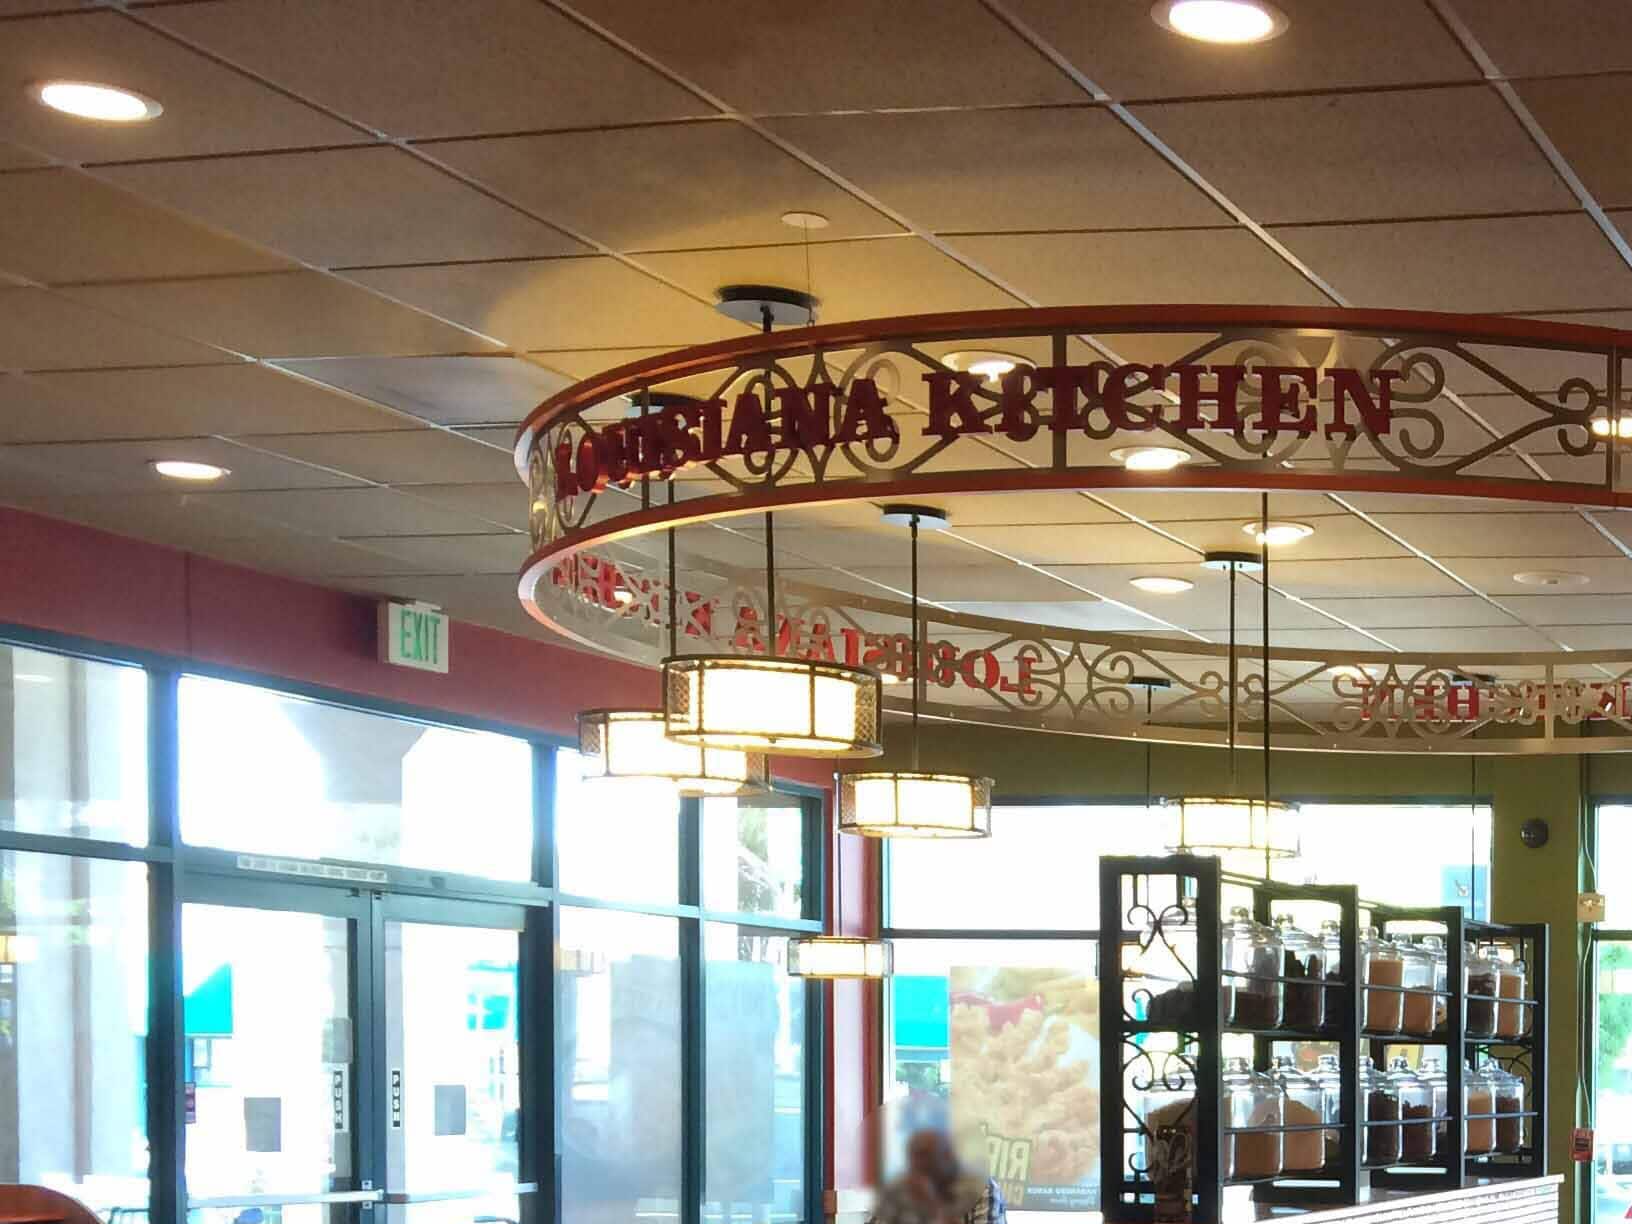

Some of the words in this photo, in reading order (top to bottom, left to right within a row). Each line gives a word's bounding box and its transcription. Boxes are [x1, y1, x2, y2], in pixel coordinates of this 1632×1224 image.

[555, 378, 899, 500] LOUISIANA
[922, 362, 1401, 440] KITCHEN
[400, 607, 441, 664] EXIT
